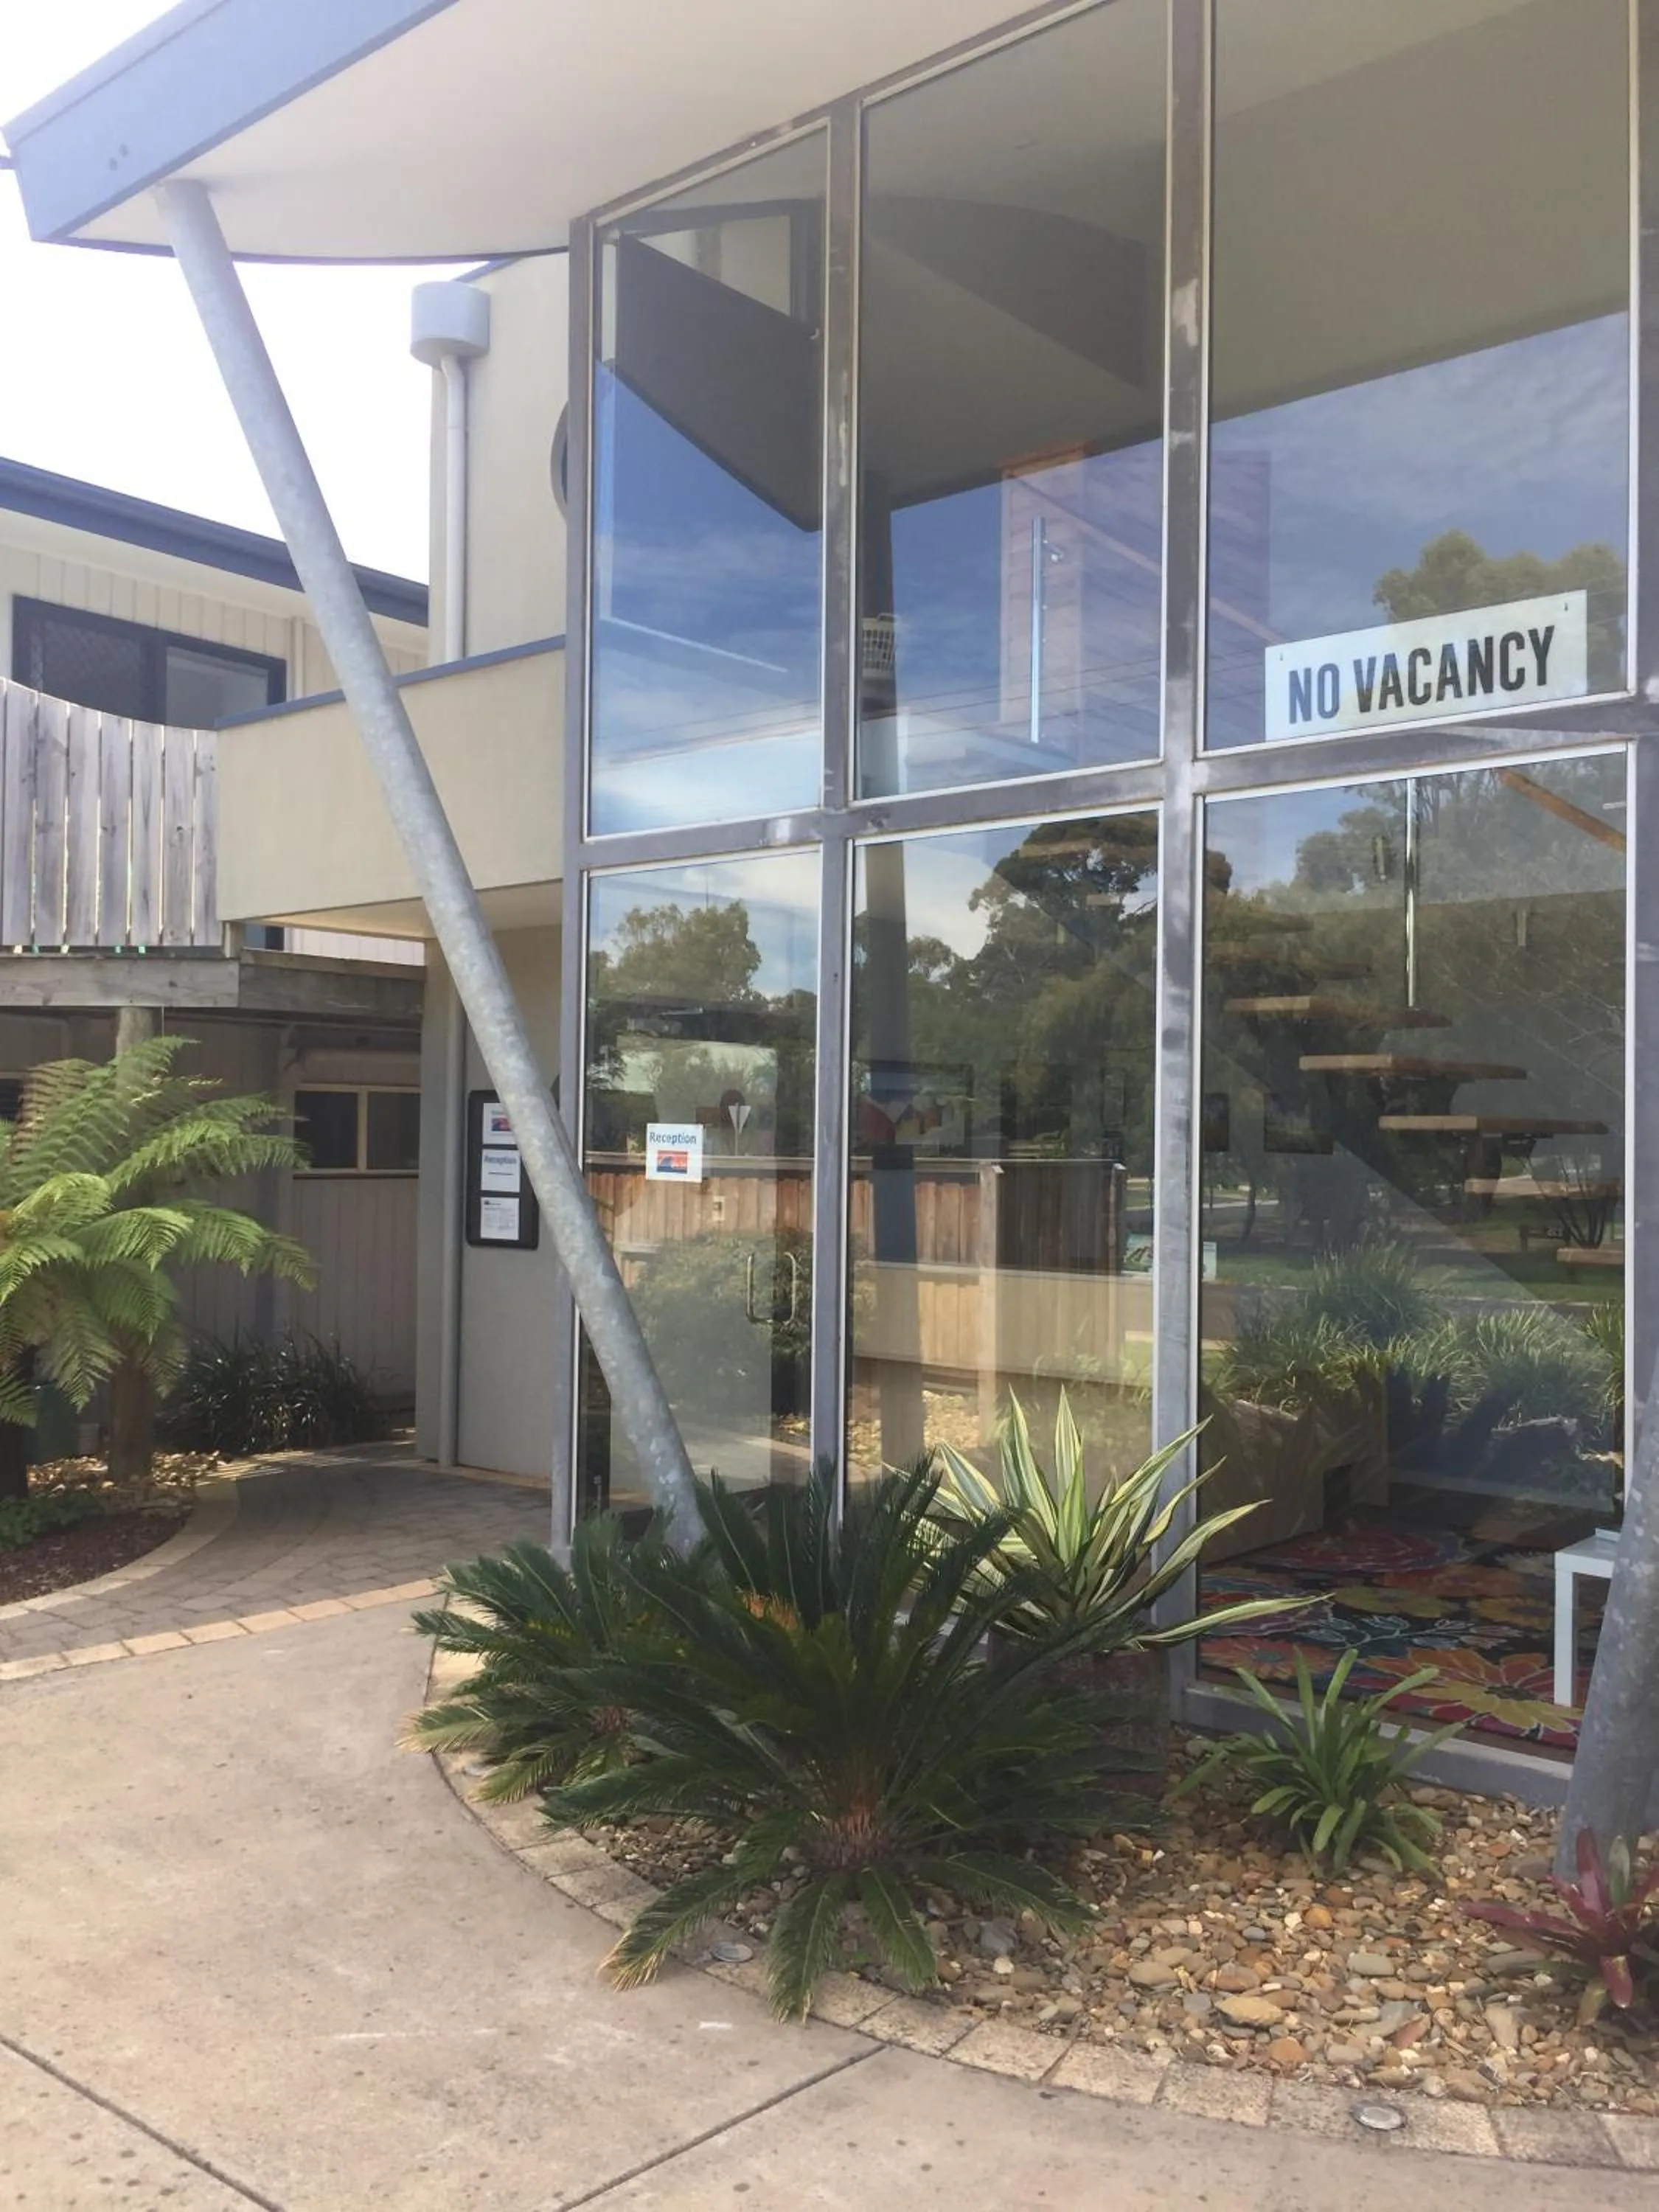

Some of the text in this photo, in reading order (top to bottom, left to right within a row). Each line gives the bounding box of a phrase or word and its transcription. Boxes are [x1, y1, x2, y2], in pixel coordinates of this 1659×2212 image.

[1289, 625, 1555, 723] NO VACANCY
[649, 1132, 697, 1146] Reception
